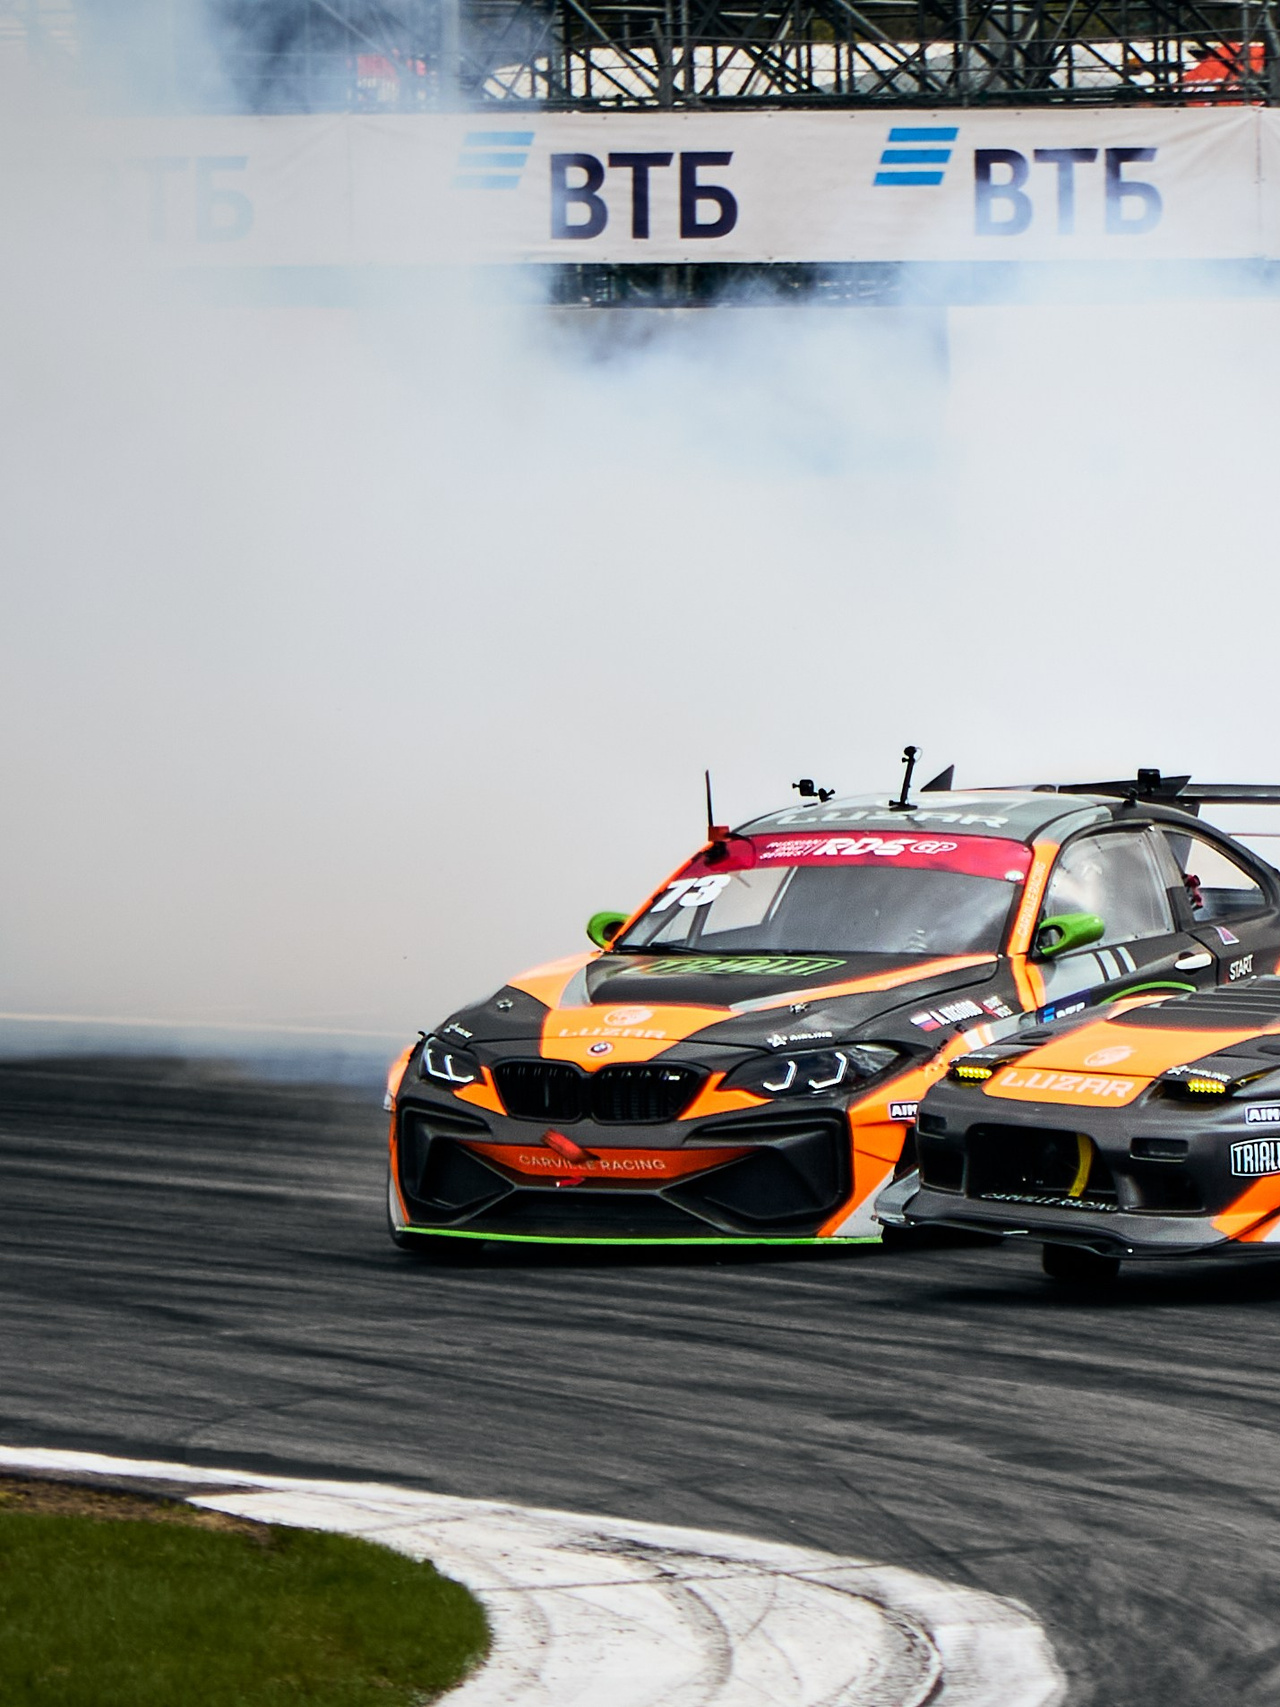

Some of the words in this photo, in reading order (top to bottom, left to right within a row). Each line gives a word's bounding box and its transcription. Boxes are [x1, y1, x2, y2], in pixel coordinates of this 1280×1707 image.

[88, 156, 254, 242] ТБ
[551, 151, 739, 239] ВТБ
[974, 147, 1164, 236] ВТБ
[812, 838, 917, 856] RDS
[1229, 953, 1253, 980] START
[559, 1027, 667, 1039] LUZAR
[1000, 1072, 1135, 1099] LUZAR
[892, 1103, 918, 1117] AIM
[600, 1158, 666, 1171] RACING
